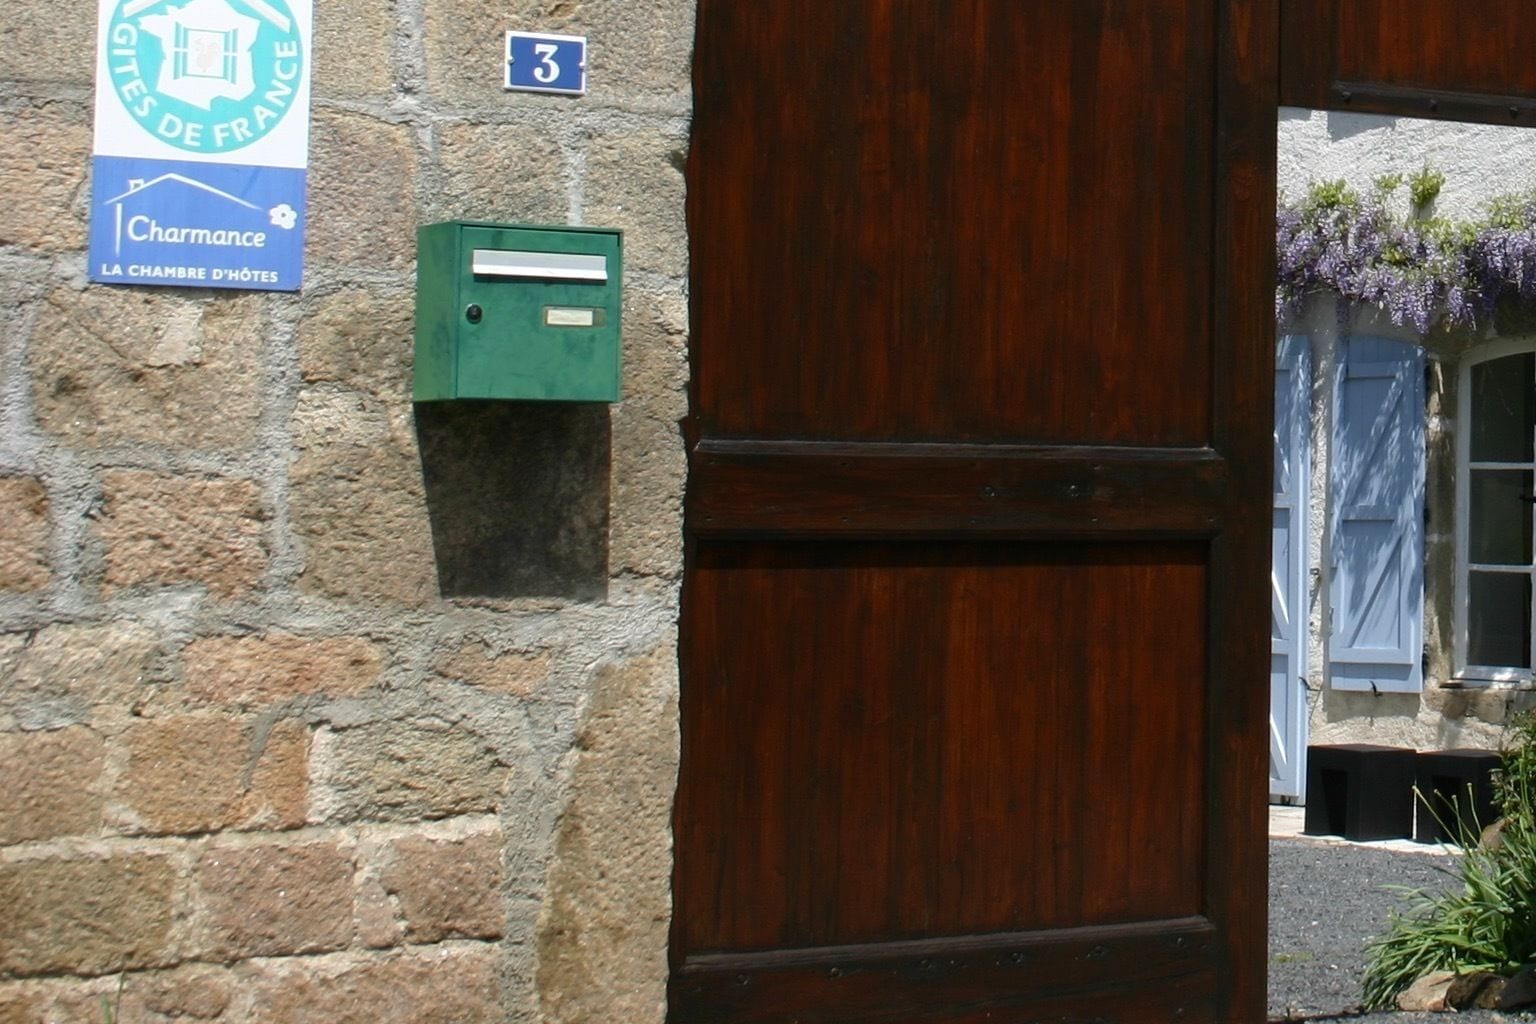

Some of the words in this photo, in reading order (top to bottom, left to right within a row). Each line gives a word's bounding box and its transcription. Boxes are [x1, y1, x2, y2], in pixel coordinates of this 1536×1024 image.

[534, 43, 560, 83] 3
[158, 112, 203, 147] DE
[213, 41, 298, 148] FRANCE
[127, 215, 266, 247] Charmance
[101, 264, 122, 276] LA
[128, 264, 206, 280] CHAMBRE
[212, 267, 278, 283] D'HÔTES
